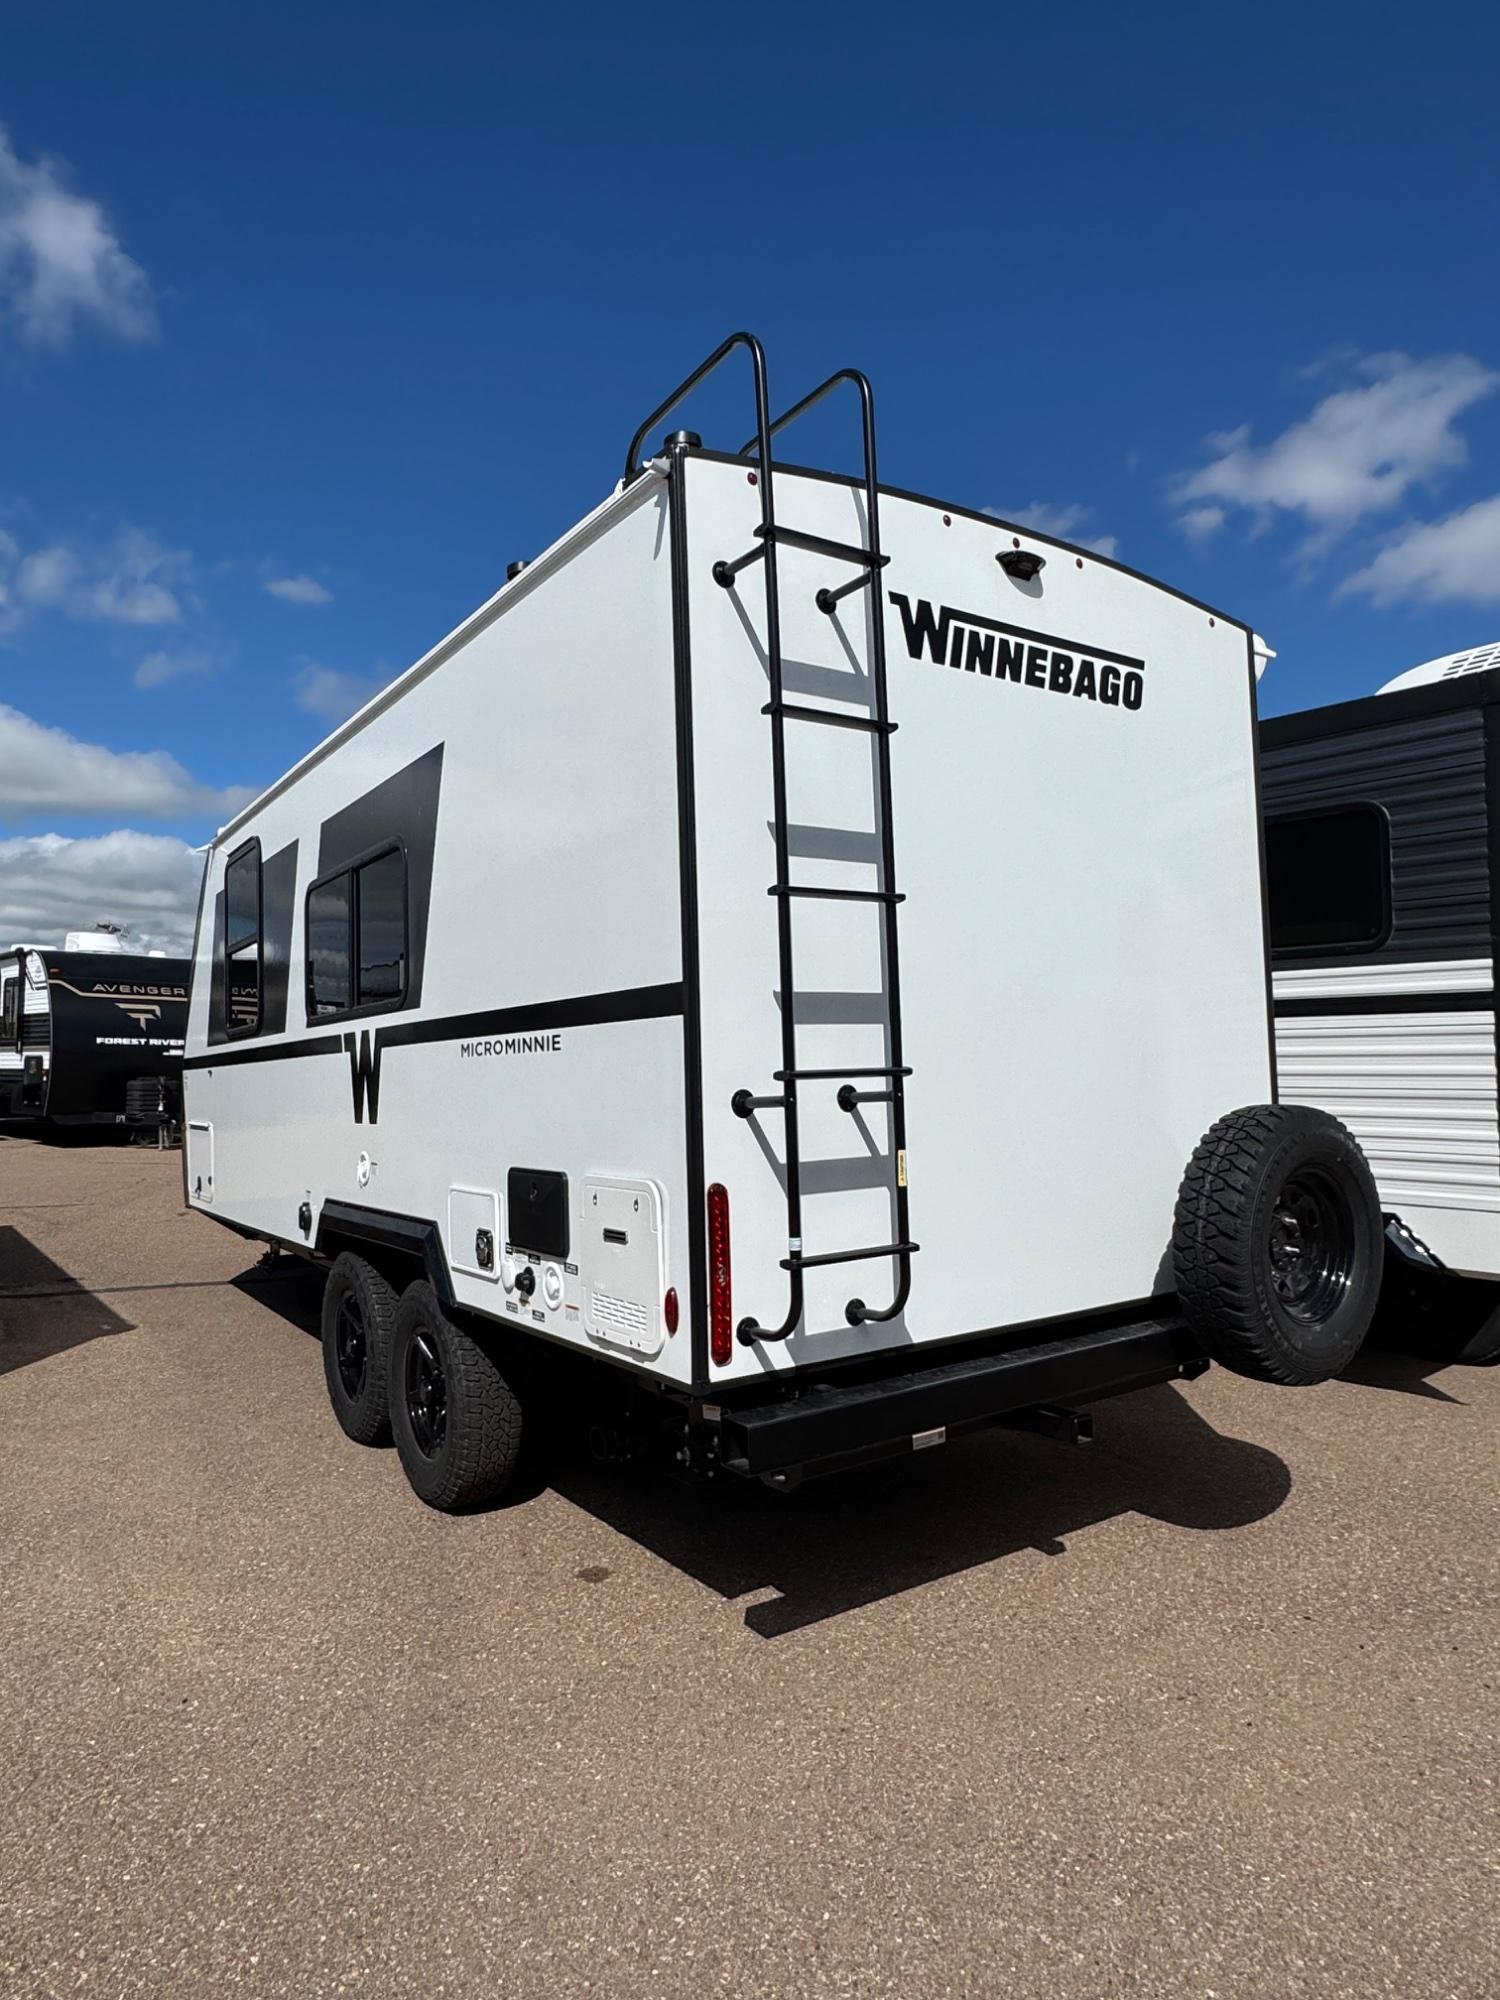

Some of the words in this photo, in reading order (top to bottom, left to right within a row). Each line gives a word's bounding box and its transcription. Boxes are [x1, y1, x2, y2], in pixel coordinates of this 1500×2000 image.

[888, 590, 1145, 711] WINNEBAGO
[92, 983, 186, 996] AVENGER
[96, 1037, 147, 1045] FOREST
[460, 1034, 562, 1058] MICROMINNIE
